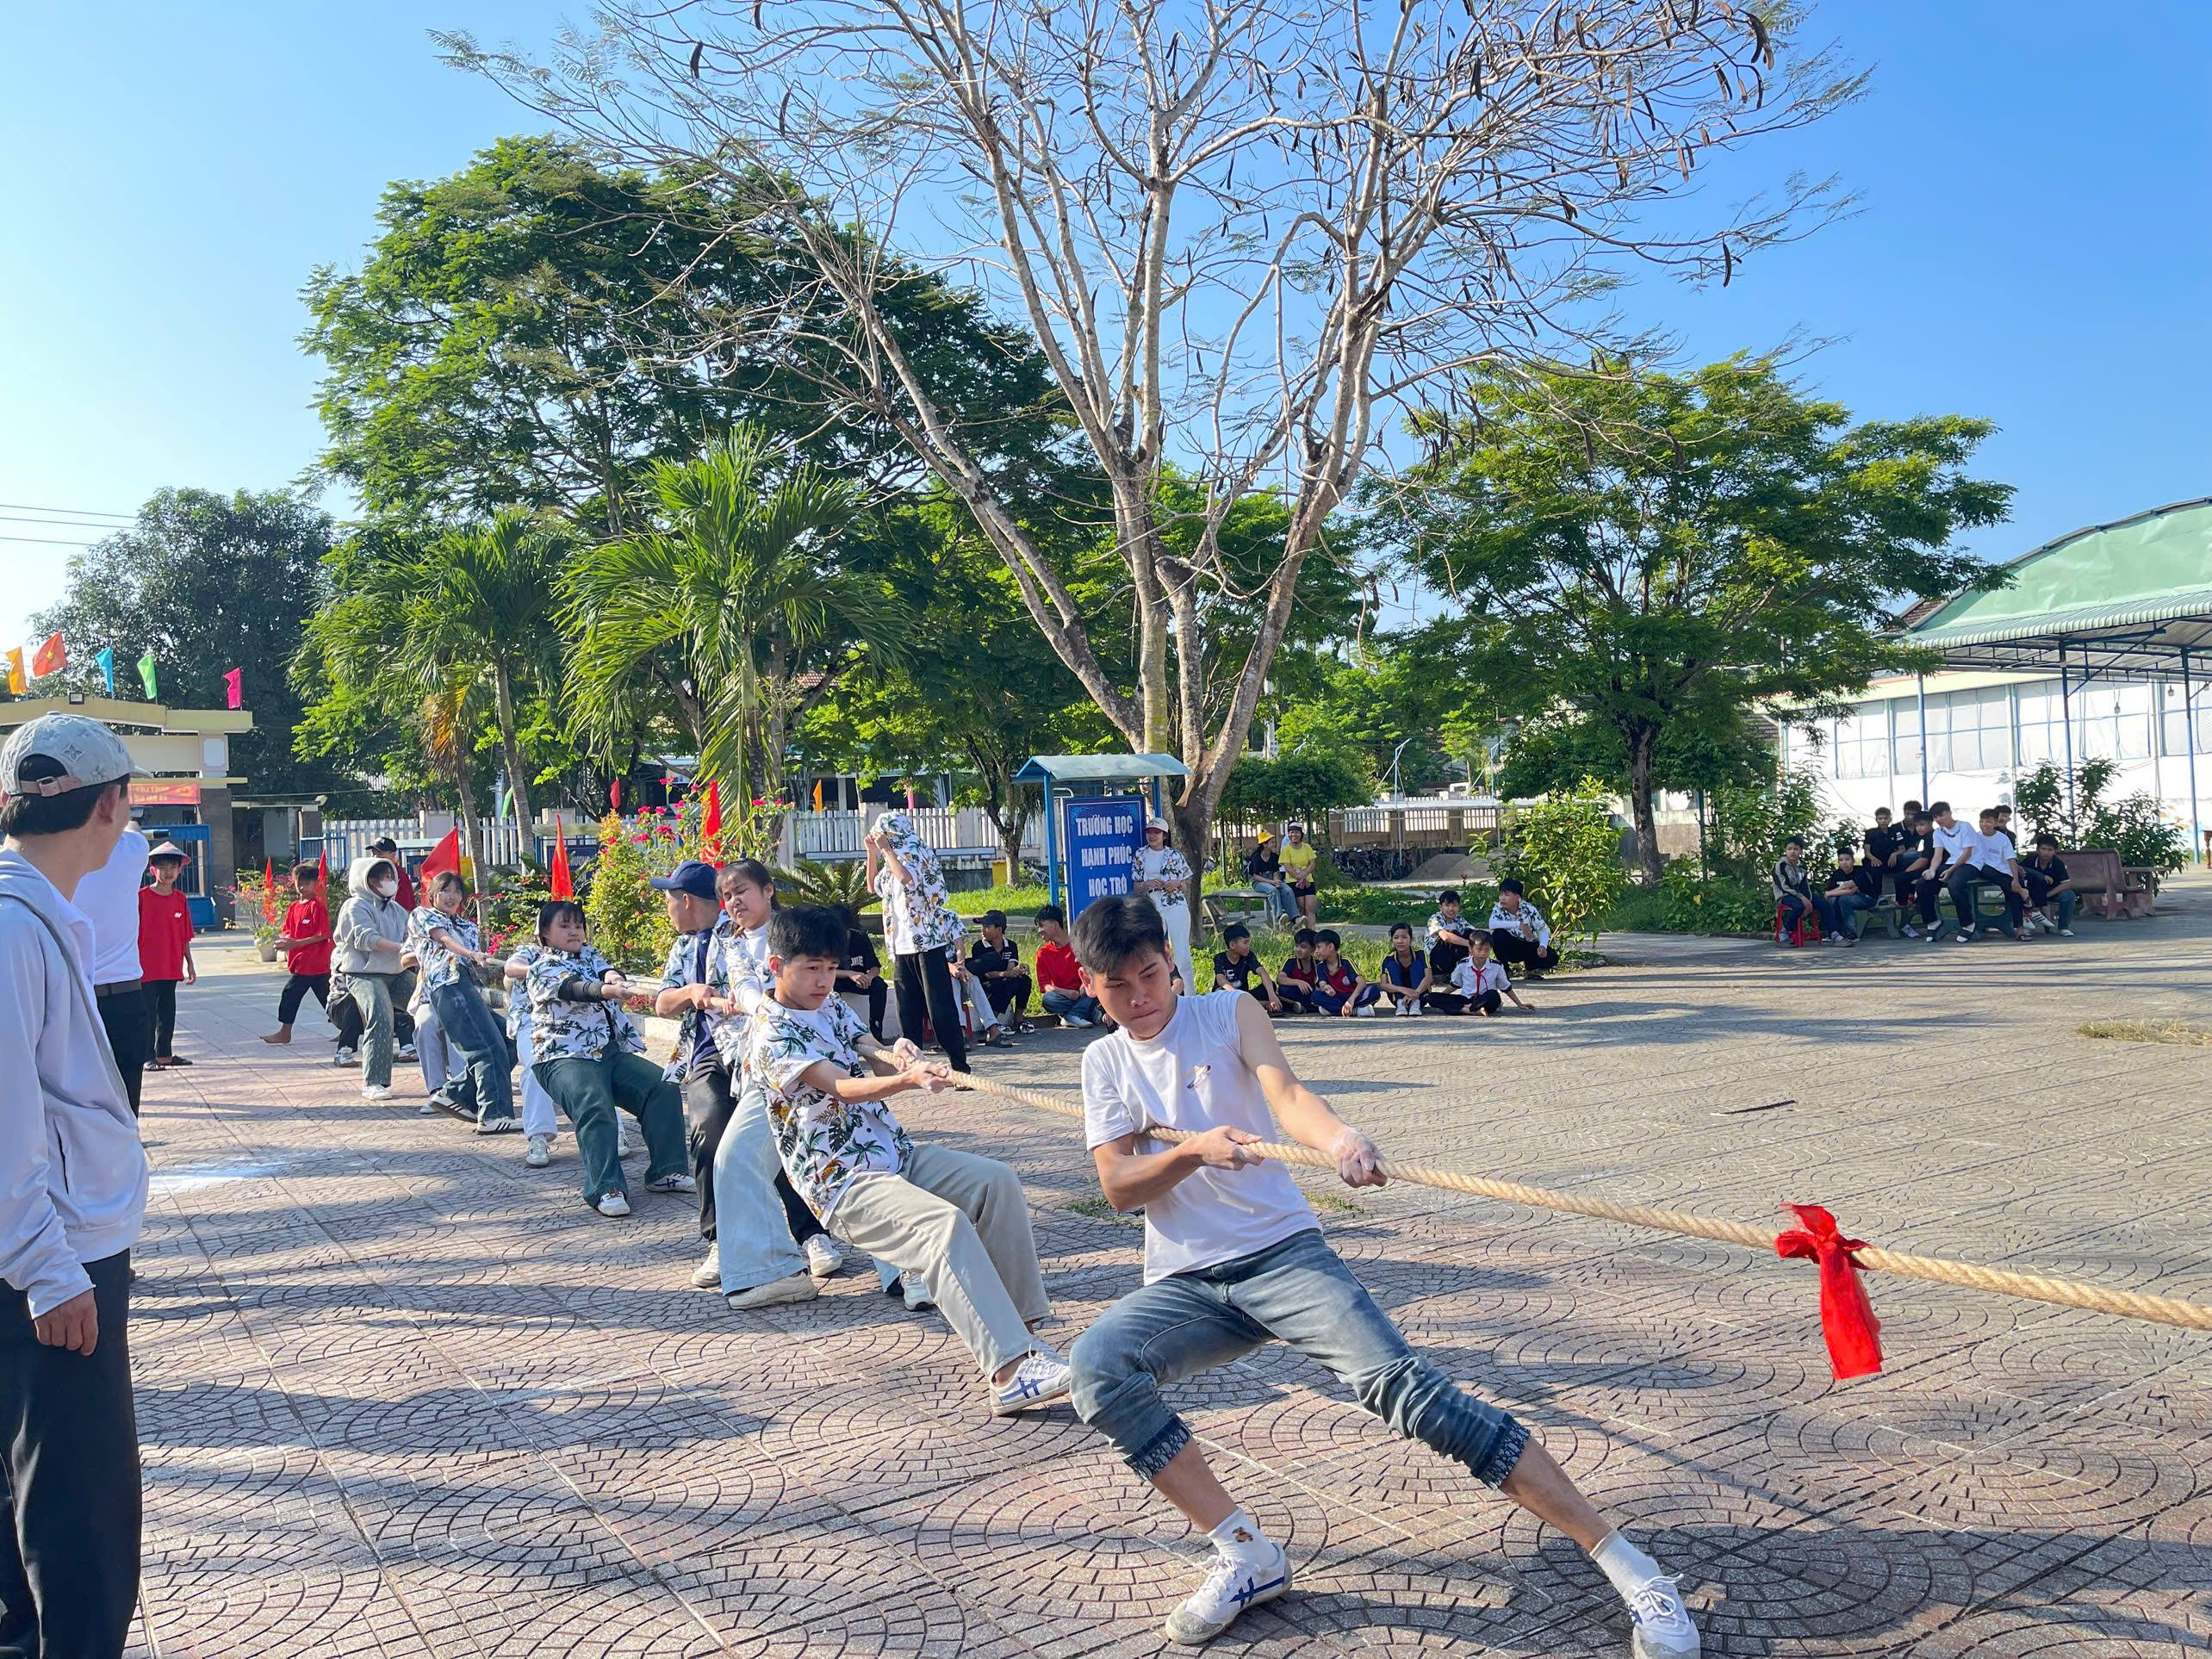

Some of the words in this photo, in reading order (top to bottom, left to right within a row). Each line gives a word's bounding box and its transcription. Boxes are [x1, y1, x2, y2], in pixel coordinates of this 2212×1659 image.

[1076, 814, 1112, 836] TRƯỜNG
[1115, 815, 1134, 837] HỌC
[1081, 848, 1106, 870] HẠNH
[1108, 843, 1132, 865] PHÚC
[1088, 877, 1108, 898] HỌC
[1109, 873, 1128, 895] TRÒ
